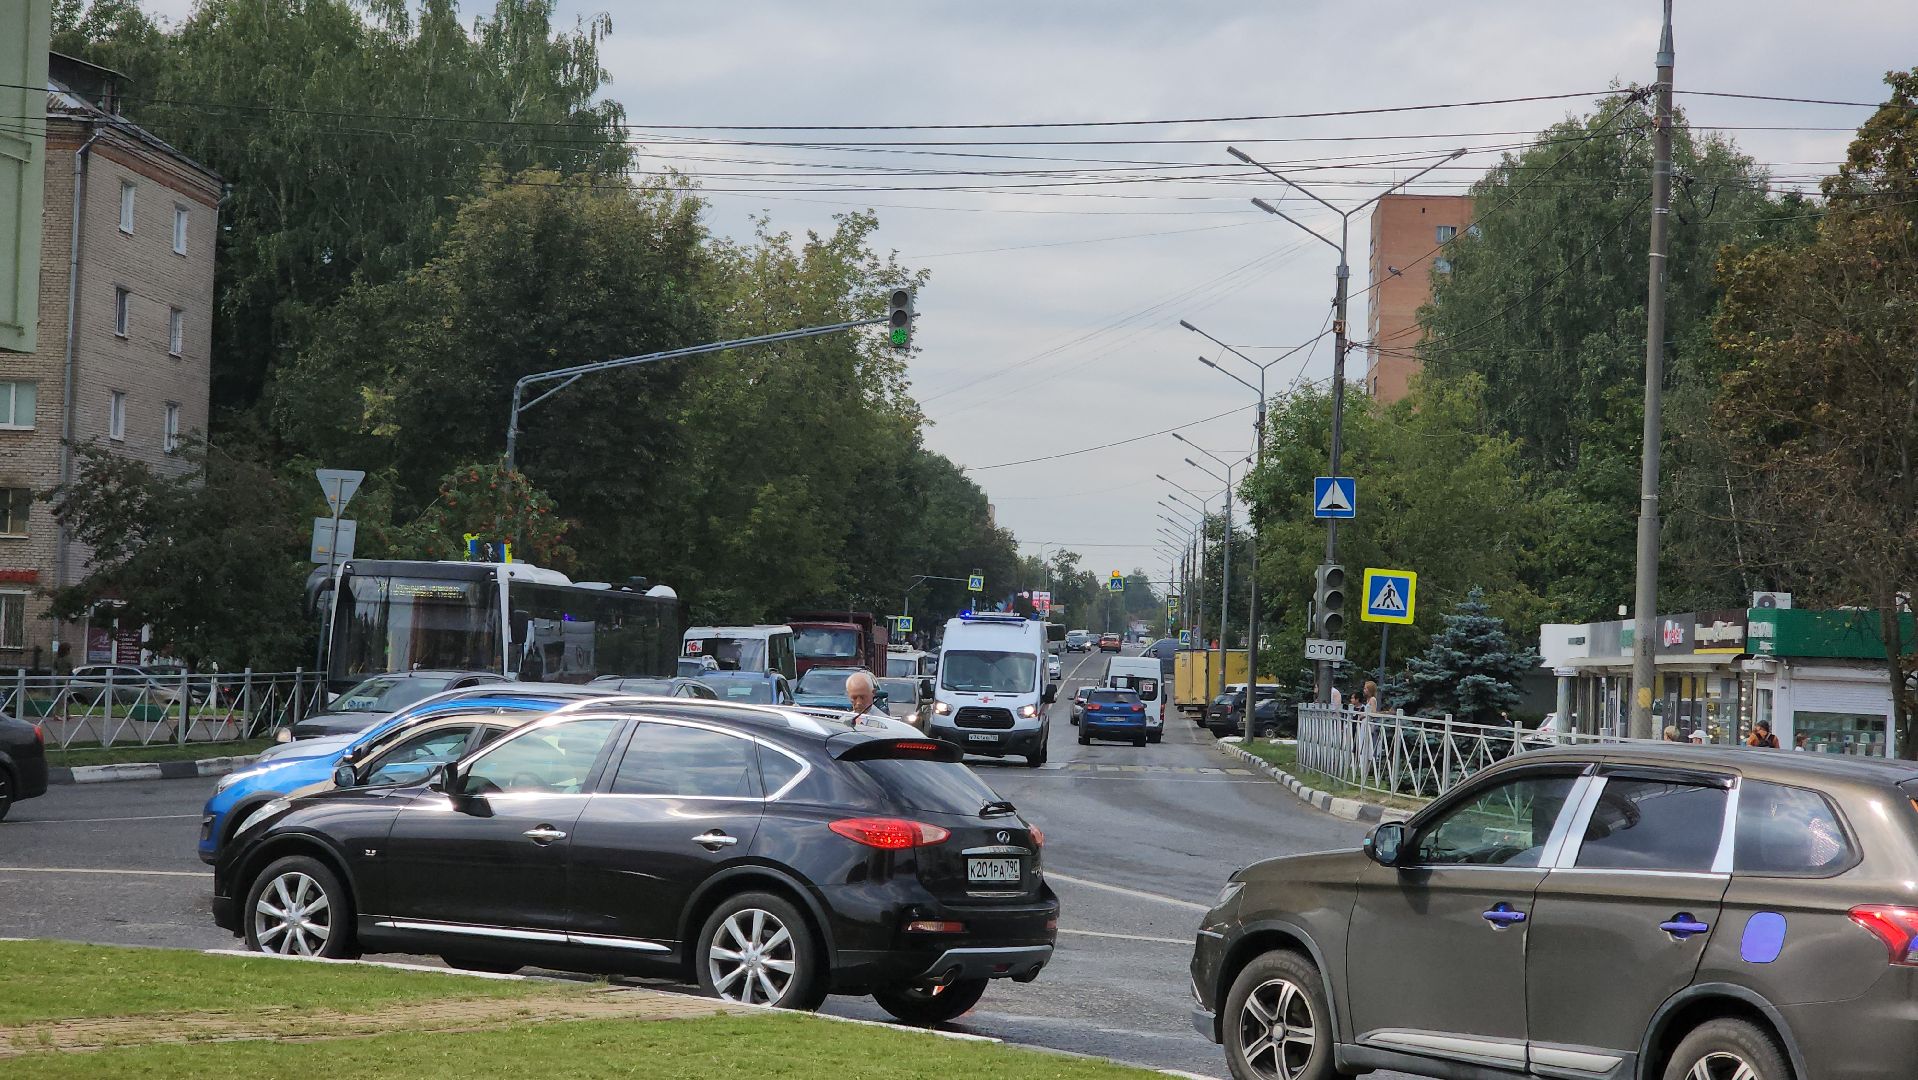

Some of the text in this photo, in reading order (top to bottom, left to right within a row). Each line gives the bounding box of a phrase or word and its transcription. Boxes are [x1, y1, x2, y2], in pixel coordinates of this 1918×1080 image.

[1308, 644, 1343, 656] СТОП
[970, 860, 1018, 878] К201РА 790
